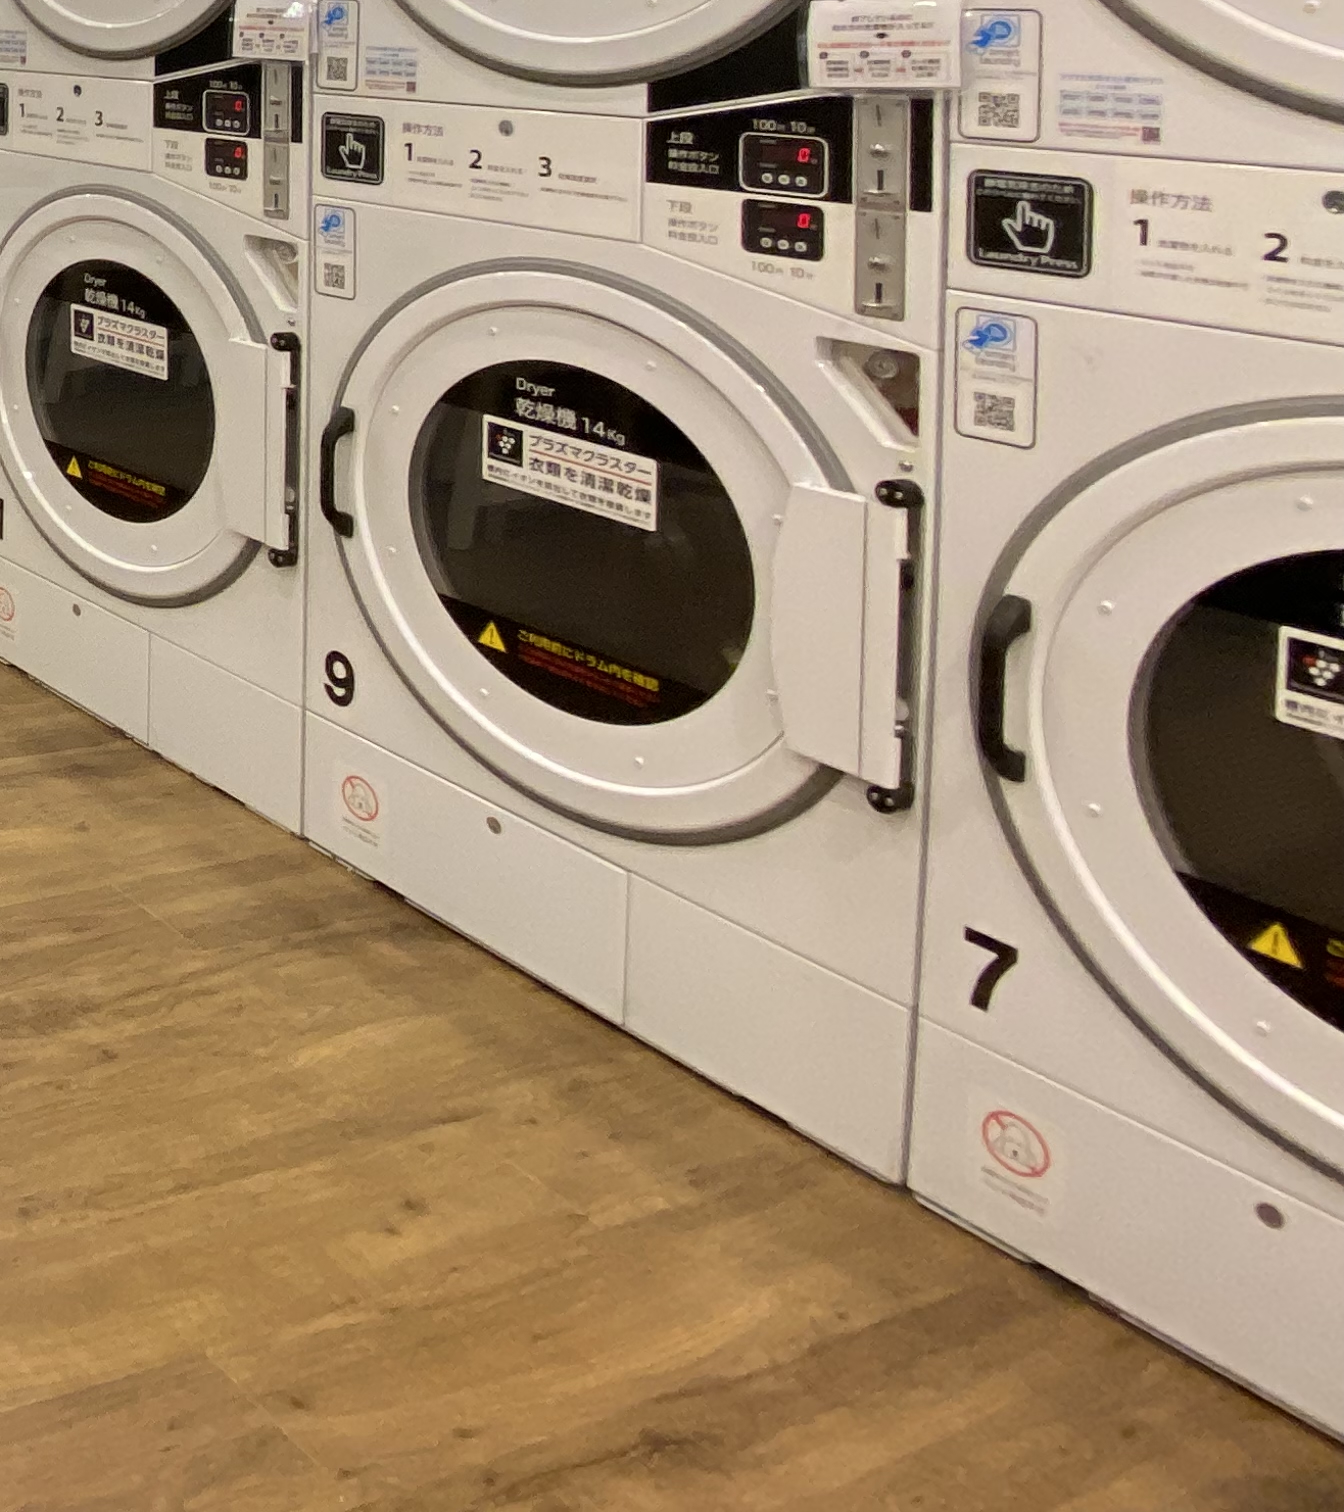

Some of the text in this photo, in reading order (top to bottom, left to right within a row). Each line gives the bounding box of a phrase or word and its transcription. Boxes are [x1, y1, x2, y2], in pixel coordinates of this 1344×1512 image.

[19, 103, 25, 118] 1
[56, 106, 65, 123] 2
[94, 110, 103, 127] 3
[404, 142, 413, 161] 1
[468, 149, 483, 169] 2
[537, 156, 552, 177] 3
[1133, 218, 1149, 246] 1
[1262, 232, 1289, 263] 2
[515, 377, 556, 397] Dryer
[529, 434, 652, 475] プラズマクラスター
[323, 650, 355, 707] 9
[964, 926, 1019, 1012] 7
